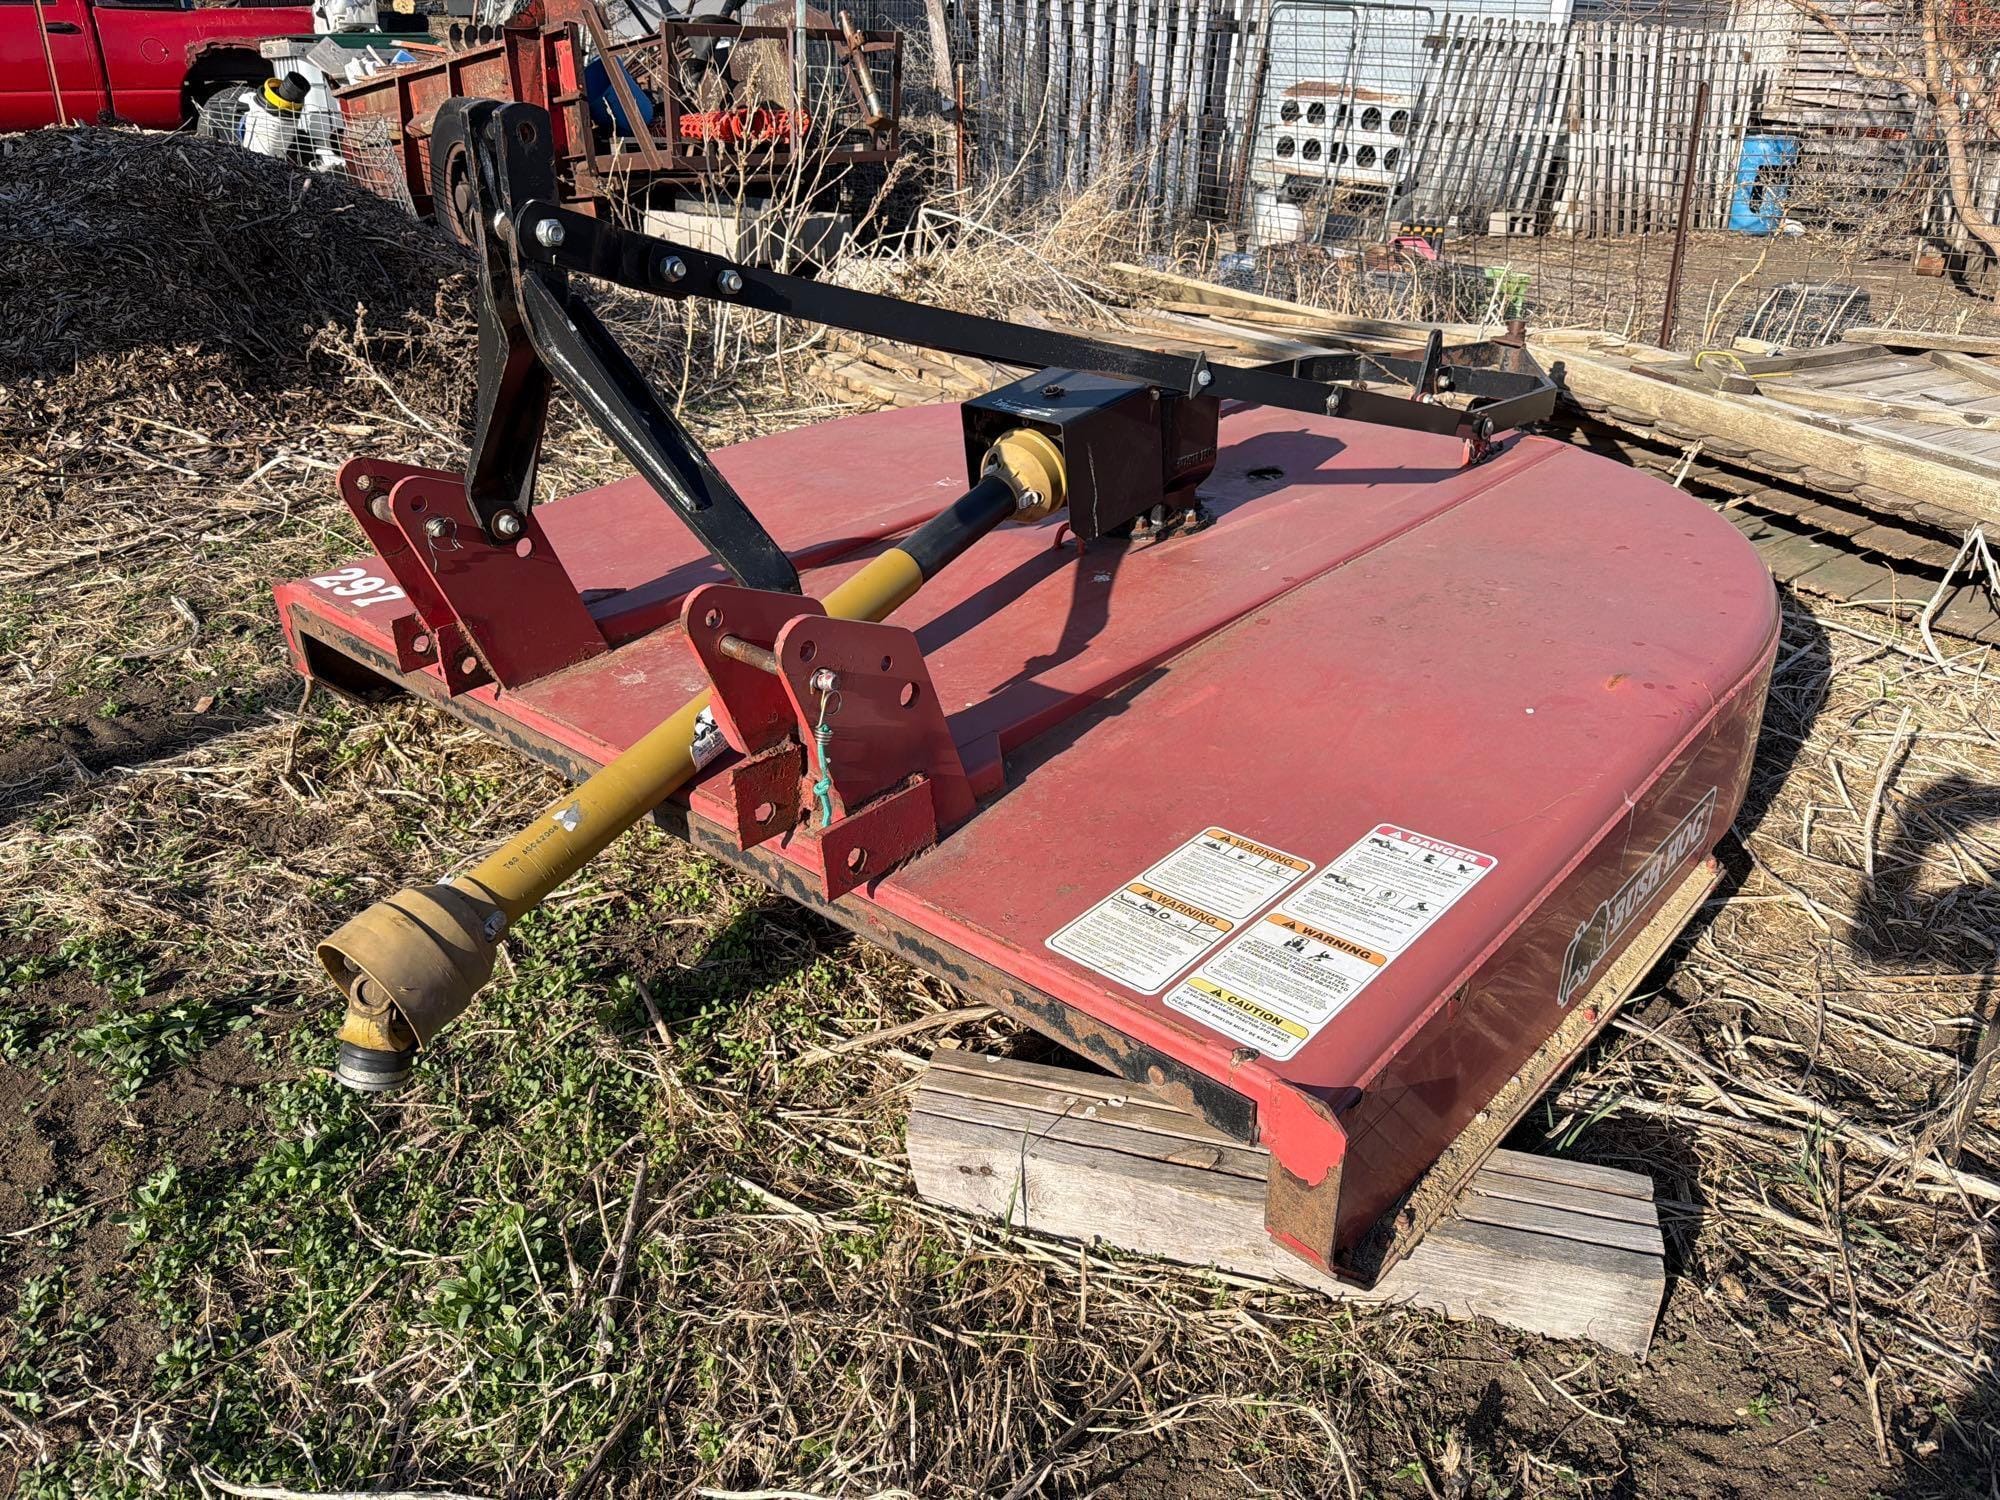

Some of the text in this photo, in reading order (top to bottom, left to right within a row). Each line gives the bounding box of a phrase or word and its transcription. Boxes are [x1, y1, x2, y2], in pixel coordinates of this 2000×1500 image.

[309, 567, 406, 608] 297
[1233, 839, 1295, 865] WARNING
[1406, 836, 1479, 862] DANGER
[1610, 808, 1705, 936] BUSH HOG
[1154, 895, 1219, 925] WARNING
[1300, 926, 1373, 960] WARNING
[1225, 995, 1283, 1026] CAUTION
